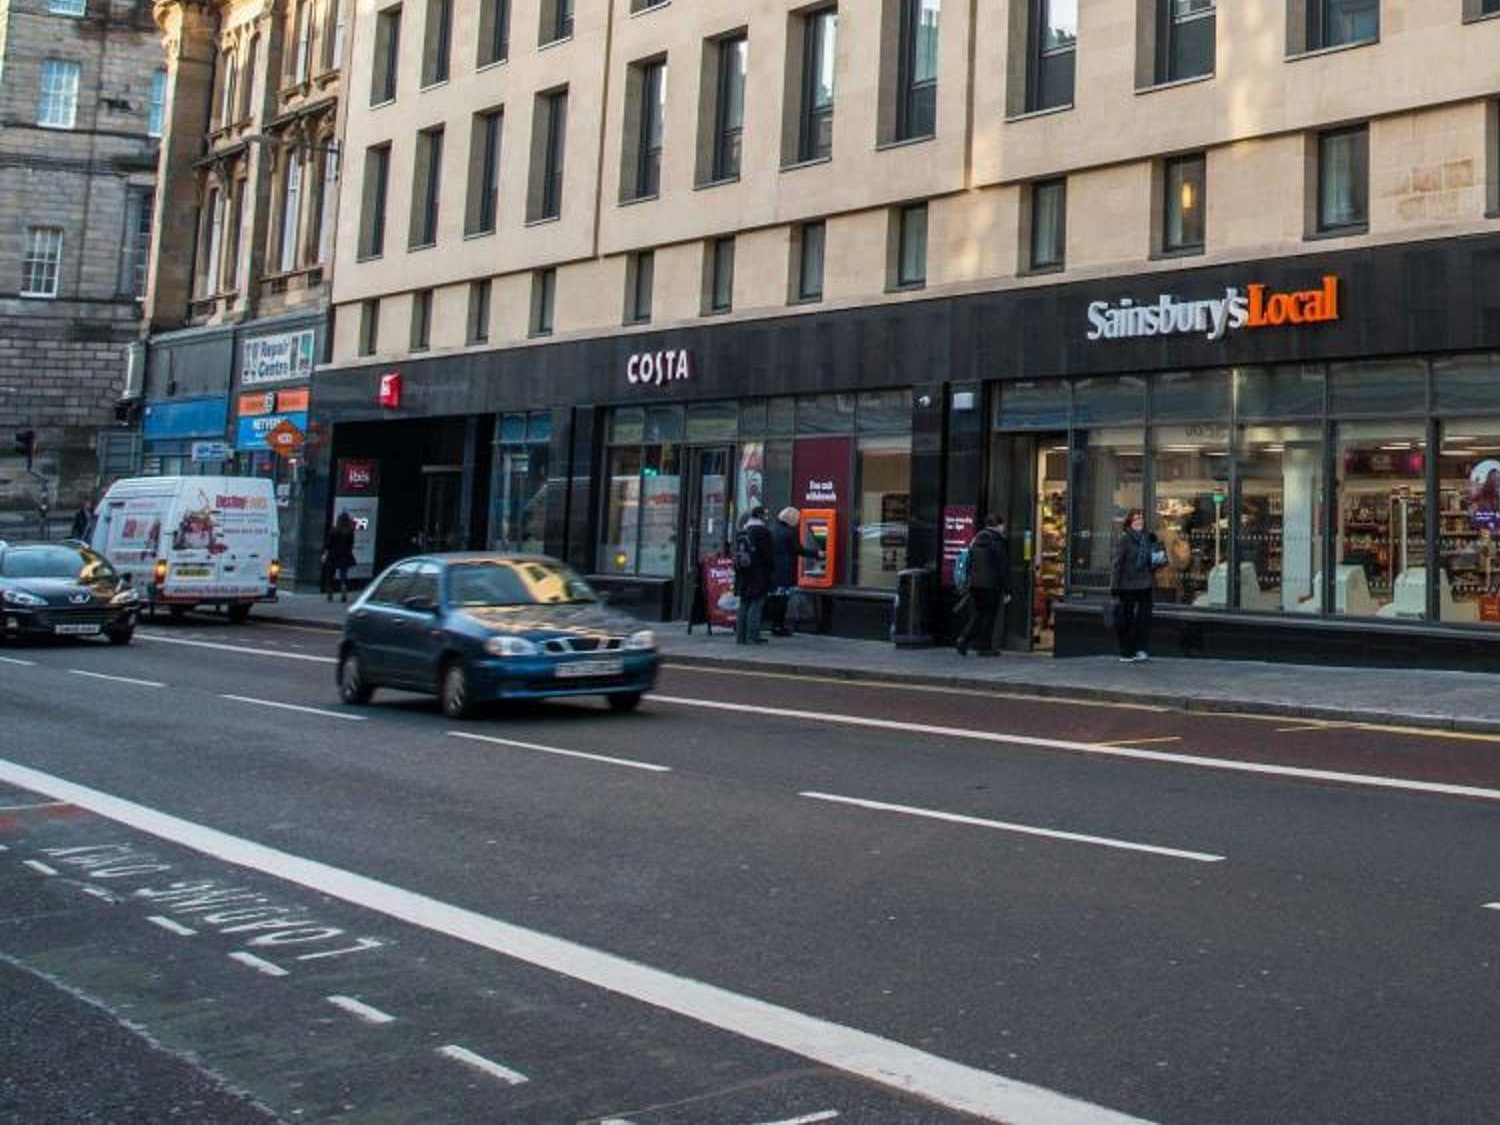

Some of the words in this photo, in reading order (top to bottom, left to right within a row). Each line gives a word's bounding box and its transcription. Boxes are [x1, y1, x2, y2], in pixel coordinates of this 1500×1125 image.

[1087, 286, 1249, 340] Sainsbury's
[1248, 275, 1339, 326] Local
[260, 339, 289, 357] Repair
[627, 349, 689, 386] COSTA
[349, 469, 371, 484] ibis
[40, 843, 172, 877] ONLY
[133, 882, 385, 961] LOADING
